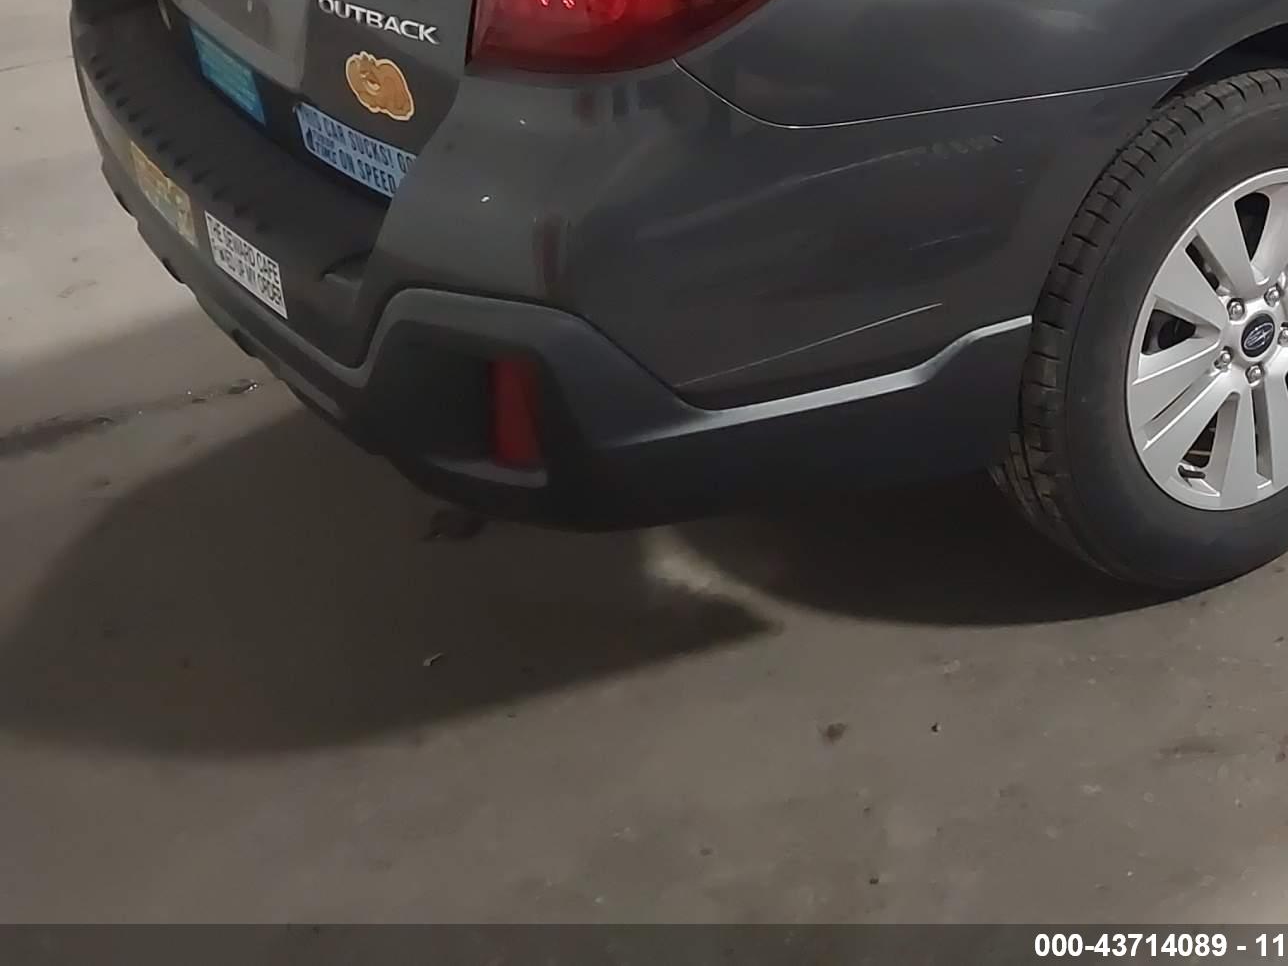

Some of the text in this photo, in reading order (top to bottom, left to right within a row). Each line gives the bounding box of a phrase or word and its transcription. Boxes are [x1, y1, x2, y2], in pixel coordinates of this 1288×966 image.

[322, 116, 347, 147] CAR
[348, 130, 395, 170] SUCKS!
[337, 149, 356, 175] ON
[356, 159, 397, 195] SPEED
[256, 252, 280, 285] CAFE
[256, 273, 284, 306] ORDER
